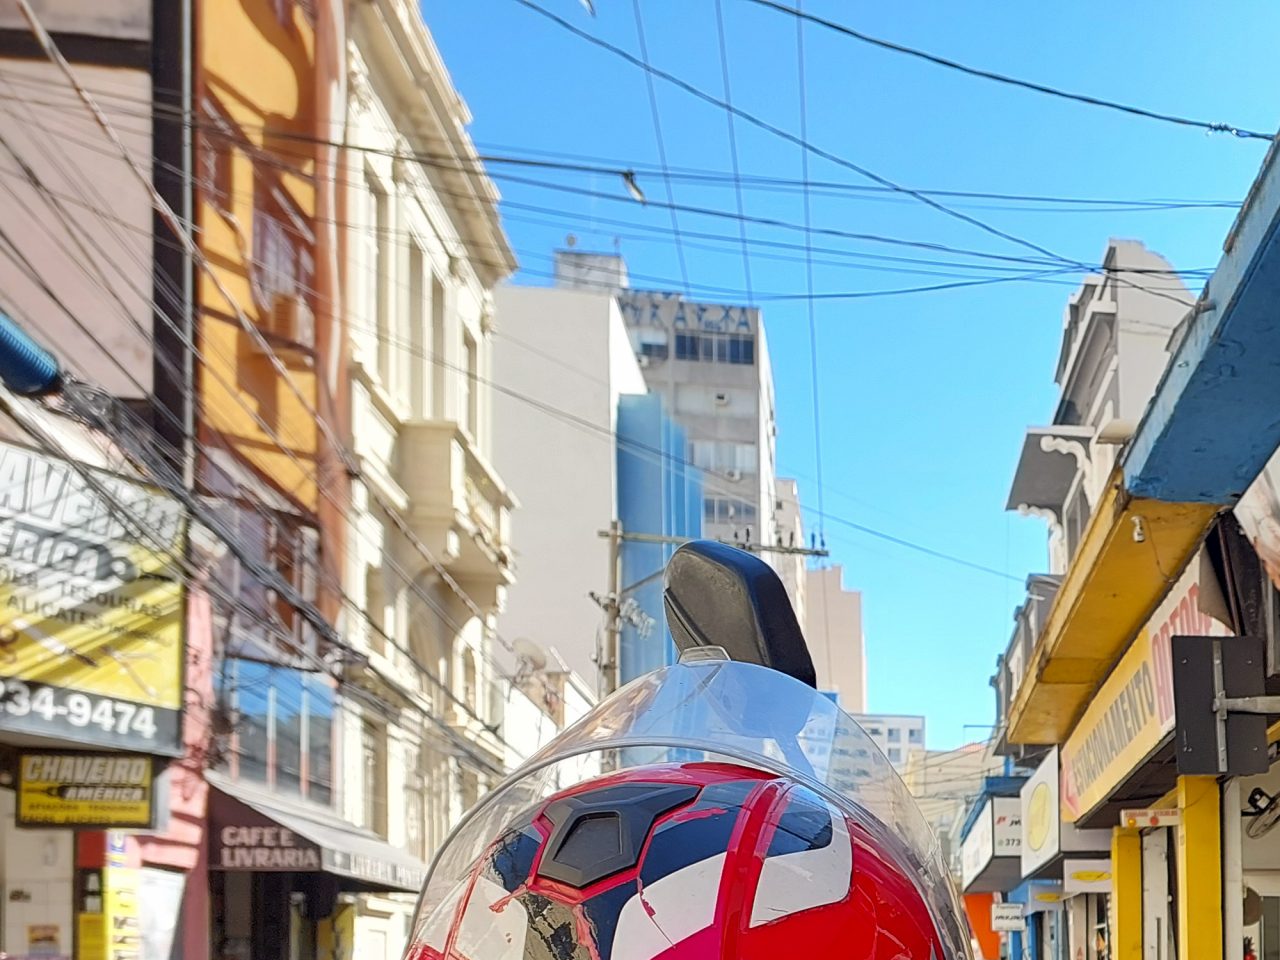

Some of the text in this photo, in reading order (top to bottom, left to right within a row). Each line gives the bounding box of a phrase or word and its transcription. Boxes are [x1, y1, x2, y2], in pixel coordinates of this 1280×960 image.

[0, 680, 158, 739] 34-9474
[26, 755, 147, 785] CHAVEIRO
[221, 847, 319, 868] LIVRARIA
